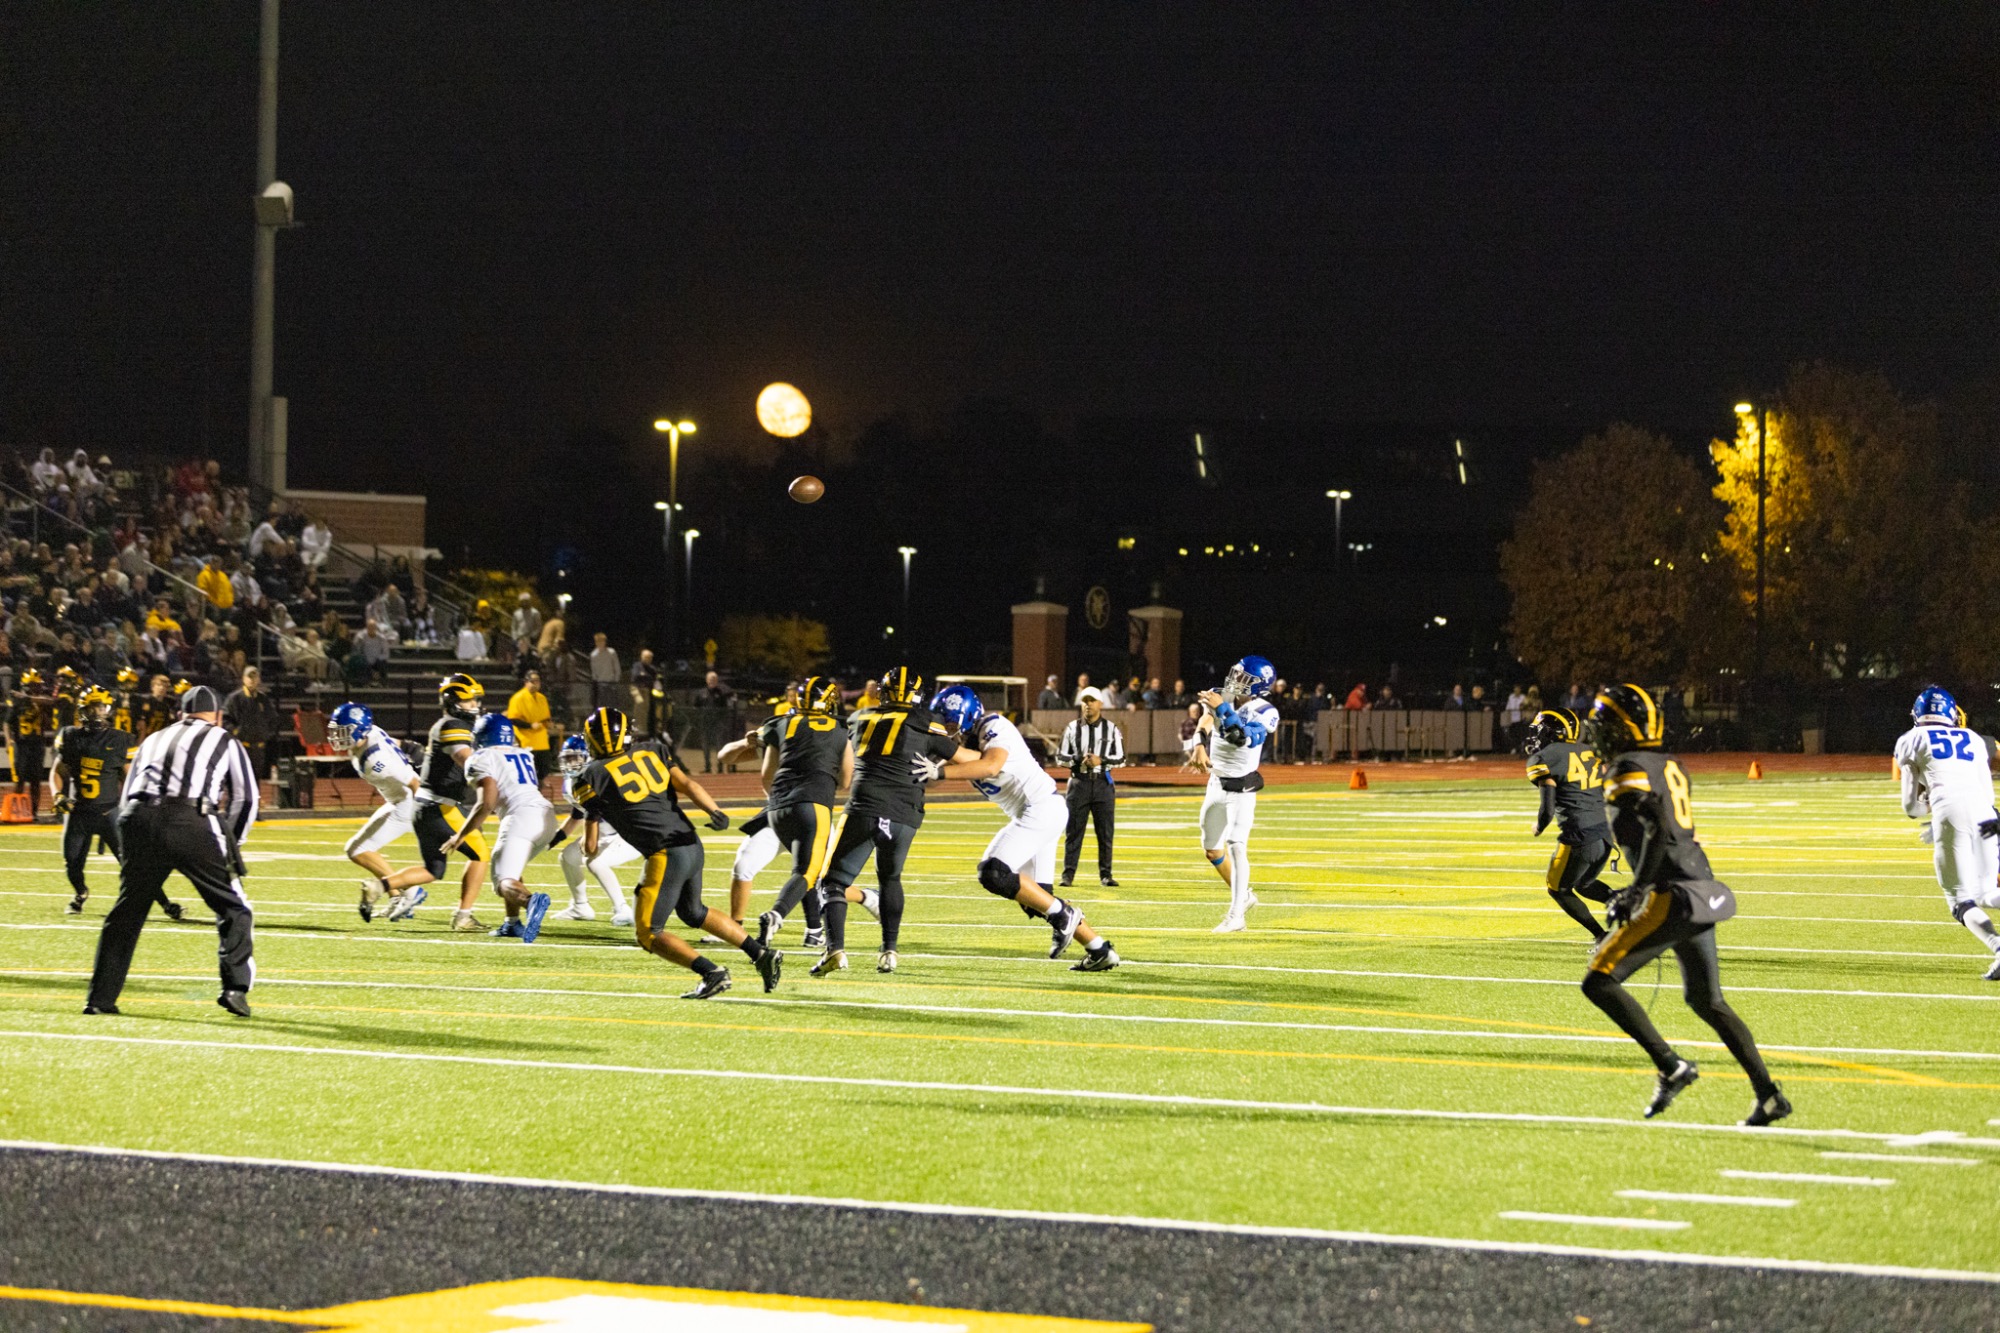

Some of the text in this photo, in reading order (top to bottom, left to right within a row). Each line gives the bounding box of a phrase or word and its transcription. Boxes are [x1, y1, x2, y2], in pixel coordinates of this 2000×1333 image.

[857, 711, 908, 757] 77
[1927, 729, 1974, 762] 52
[80, 770, 101, 799] 5
[504, 753, 539, 786] 76
[604, 749, 670, 803] 50
[1567, 750, 1602, 790] 42
[1664, 760, 1693, 829] 8
